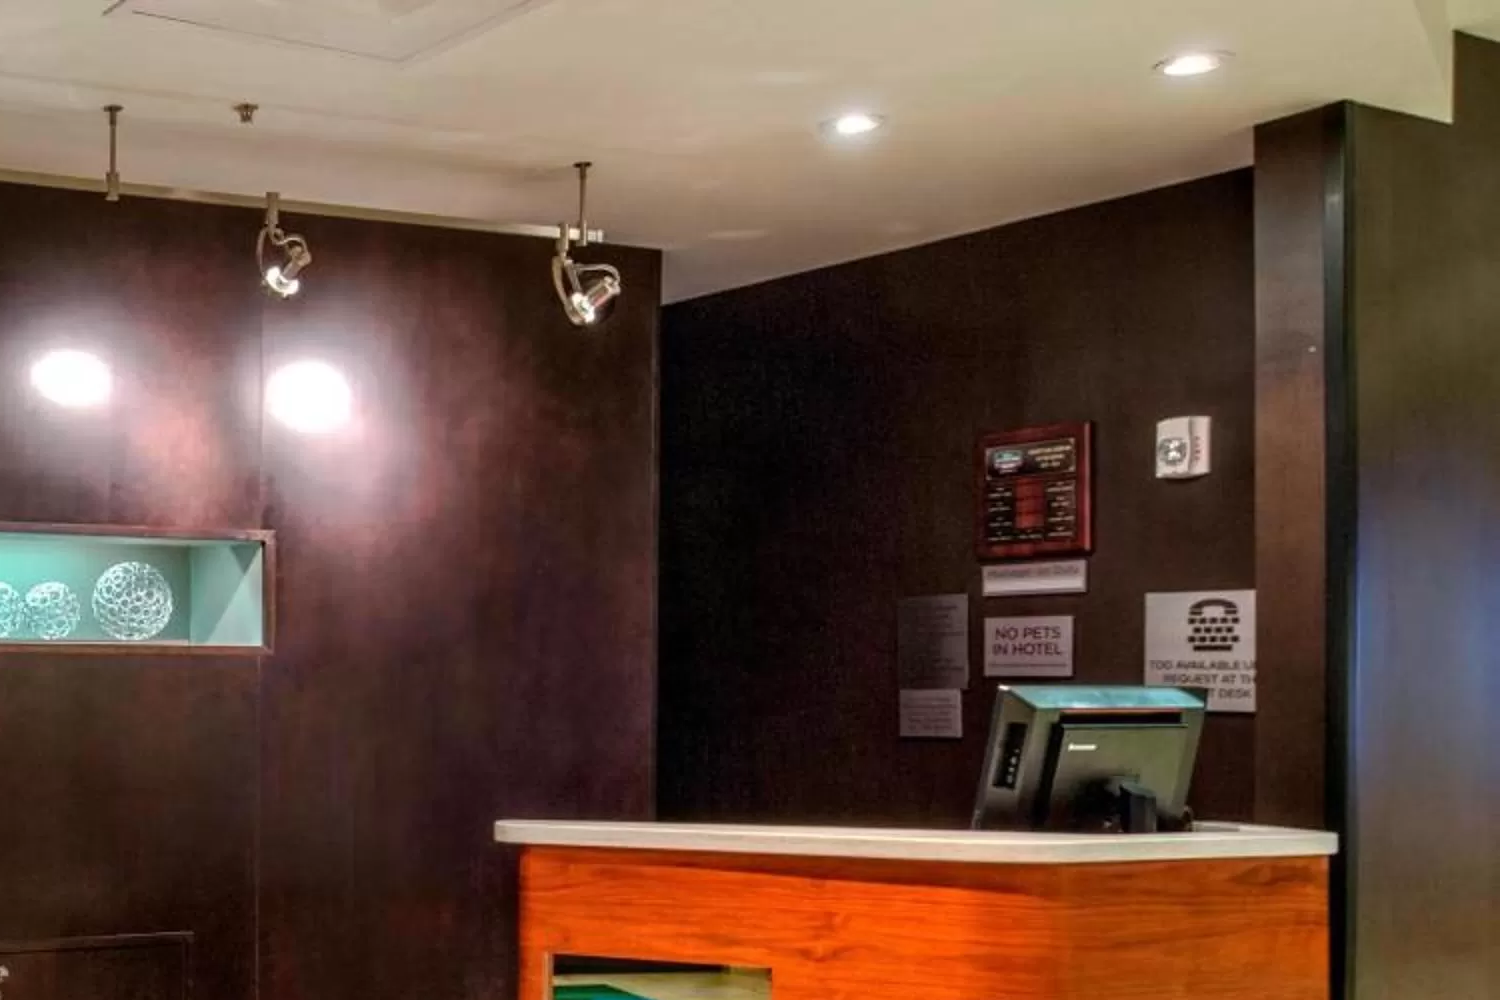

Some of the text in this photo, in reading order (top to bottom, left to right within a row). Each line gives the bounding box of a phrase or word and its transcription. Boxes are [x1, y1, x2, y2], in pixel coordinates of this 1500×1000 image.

[995, 625, 1061, 640] NO PETS
[992, 643, 1062, 656] IN HOTEL
[1176, 660, 1240, 670] AVAILABLE
[1163, 673, 1255, 684] REQUEST AT TH
[1219, 687, 1252, 698] DESK
